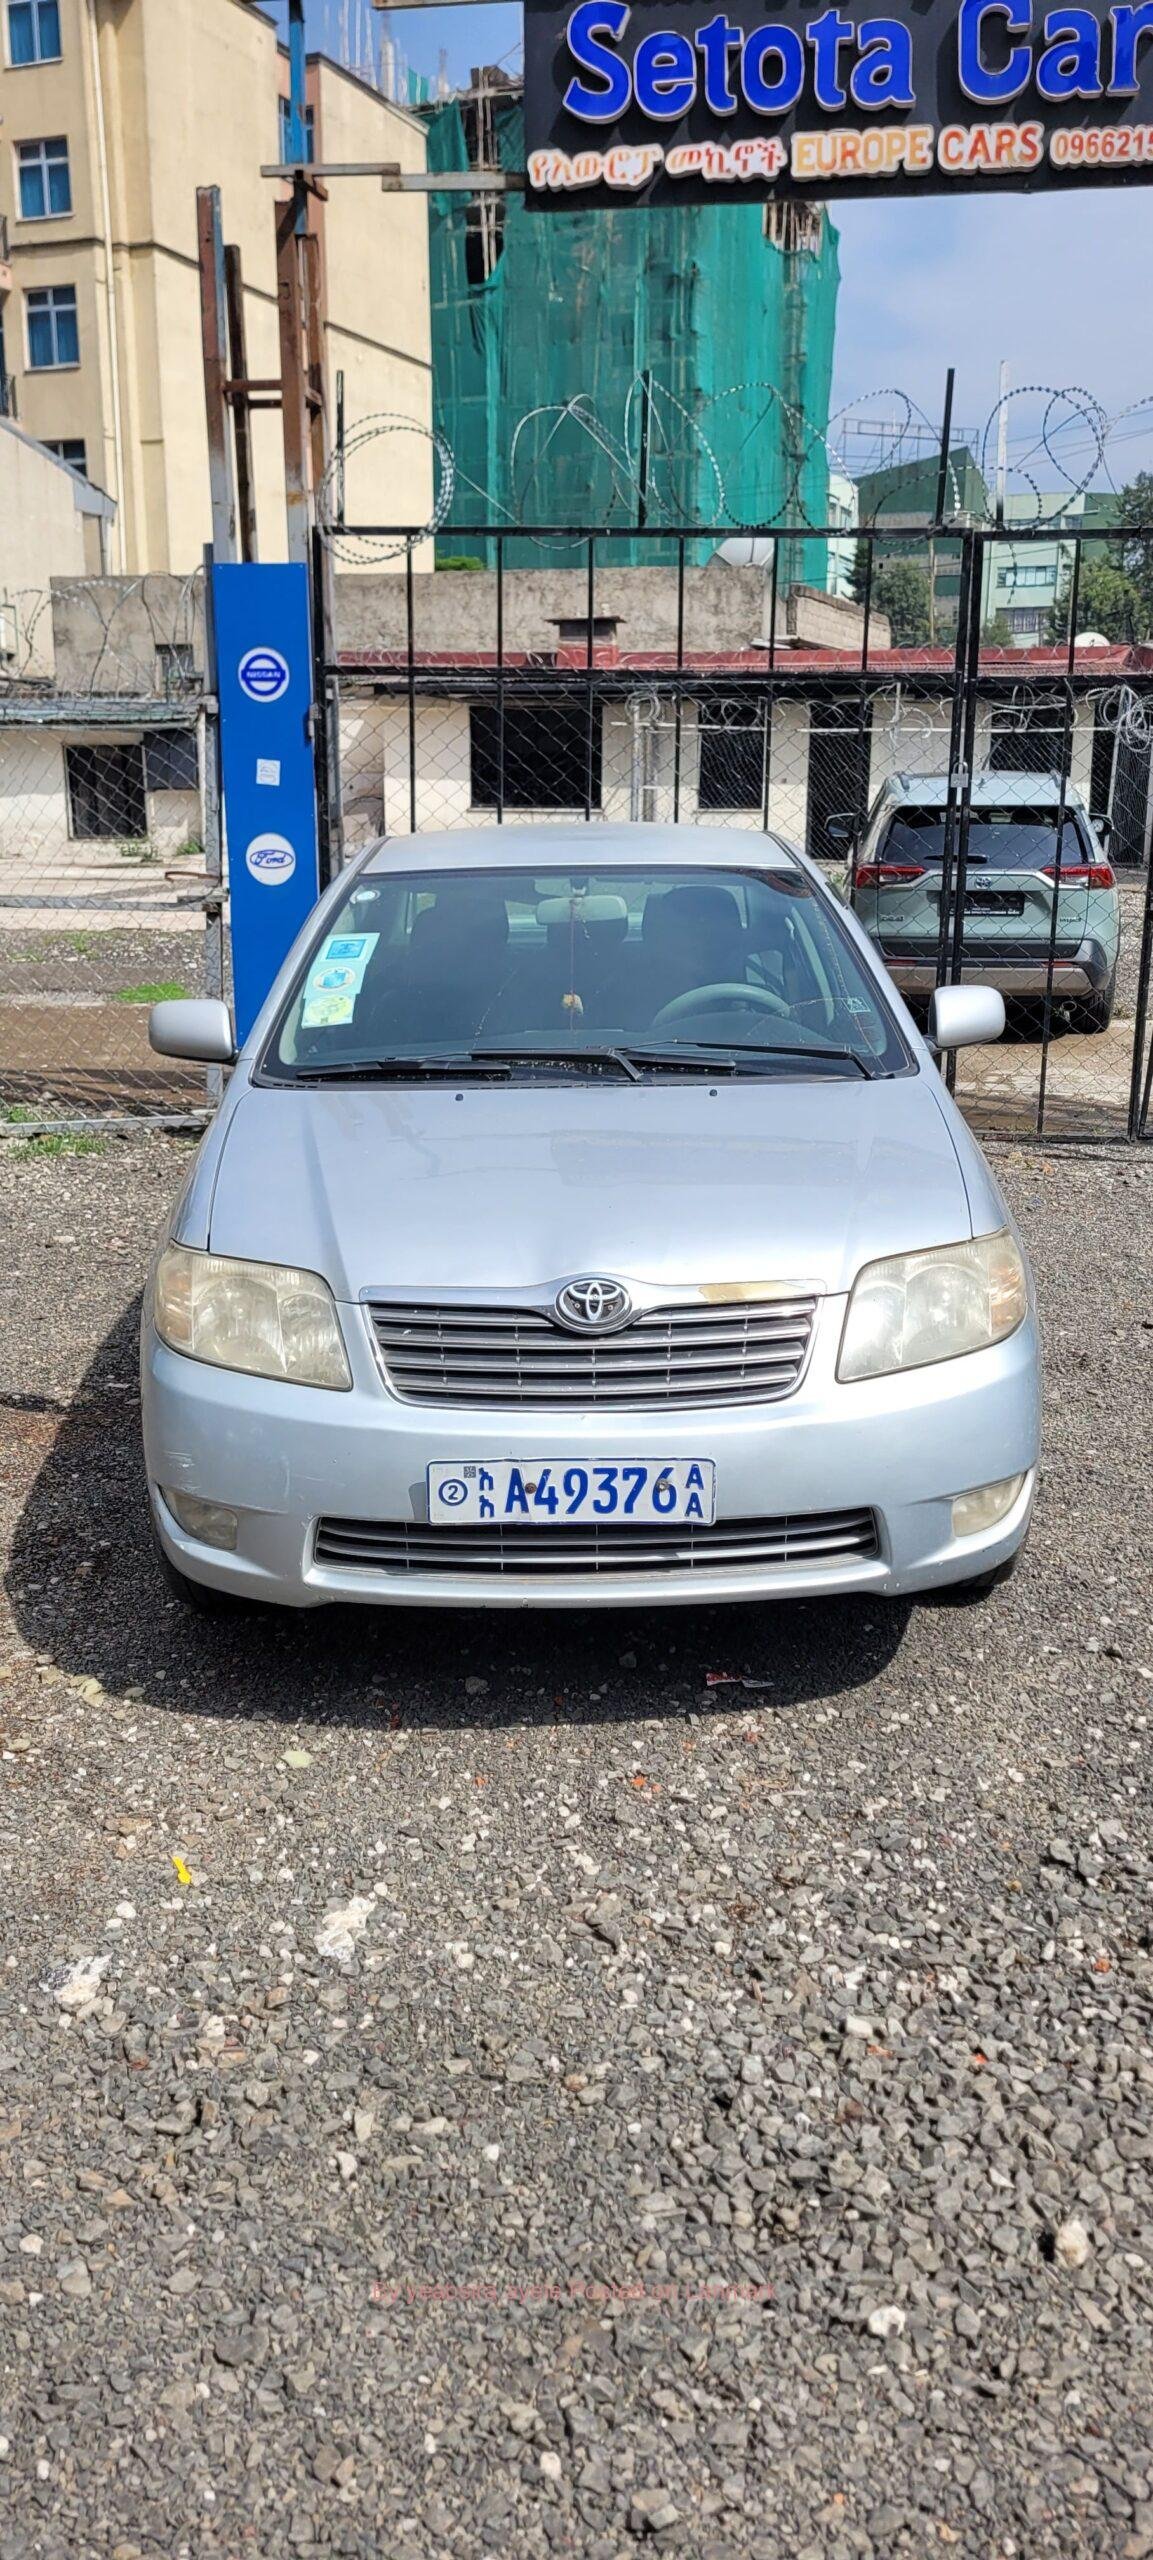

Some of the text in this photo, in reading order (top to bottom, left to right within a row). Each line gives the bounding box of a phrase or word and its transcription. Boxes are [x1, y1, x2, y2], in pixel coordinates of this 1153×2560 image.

[562, 0, 1153, 124] Setota Car
[666, 139, 786, 180] መኪኖች
[795, 128, 931, 175] EUROPE
[941, 124, 1041, 169] CARS
[246, 670, 281, 678] NISSAN
[254, 850, 286, 865] Ford
[684, 1463, 704, 1490] A
[504, 1467, 677, 1514] A49376
[684, 1492, 704, 1518] A
